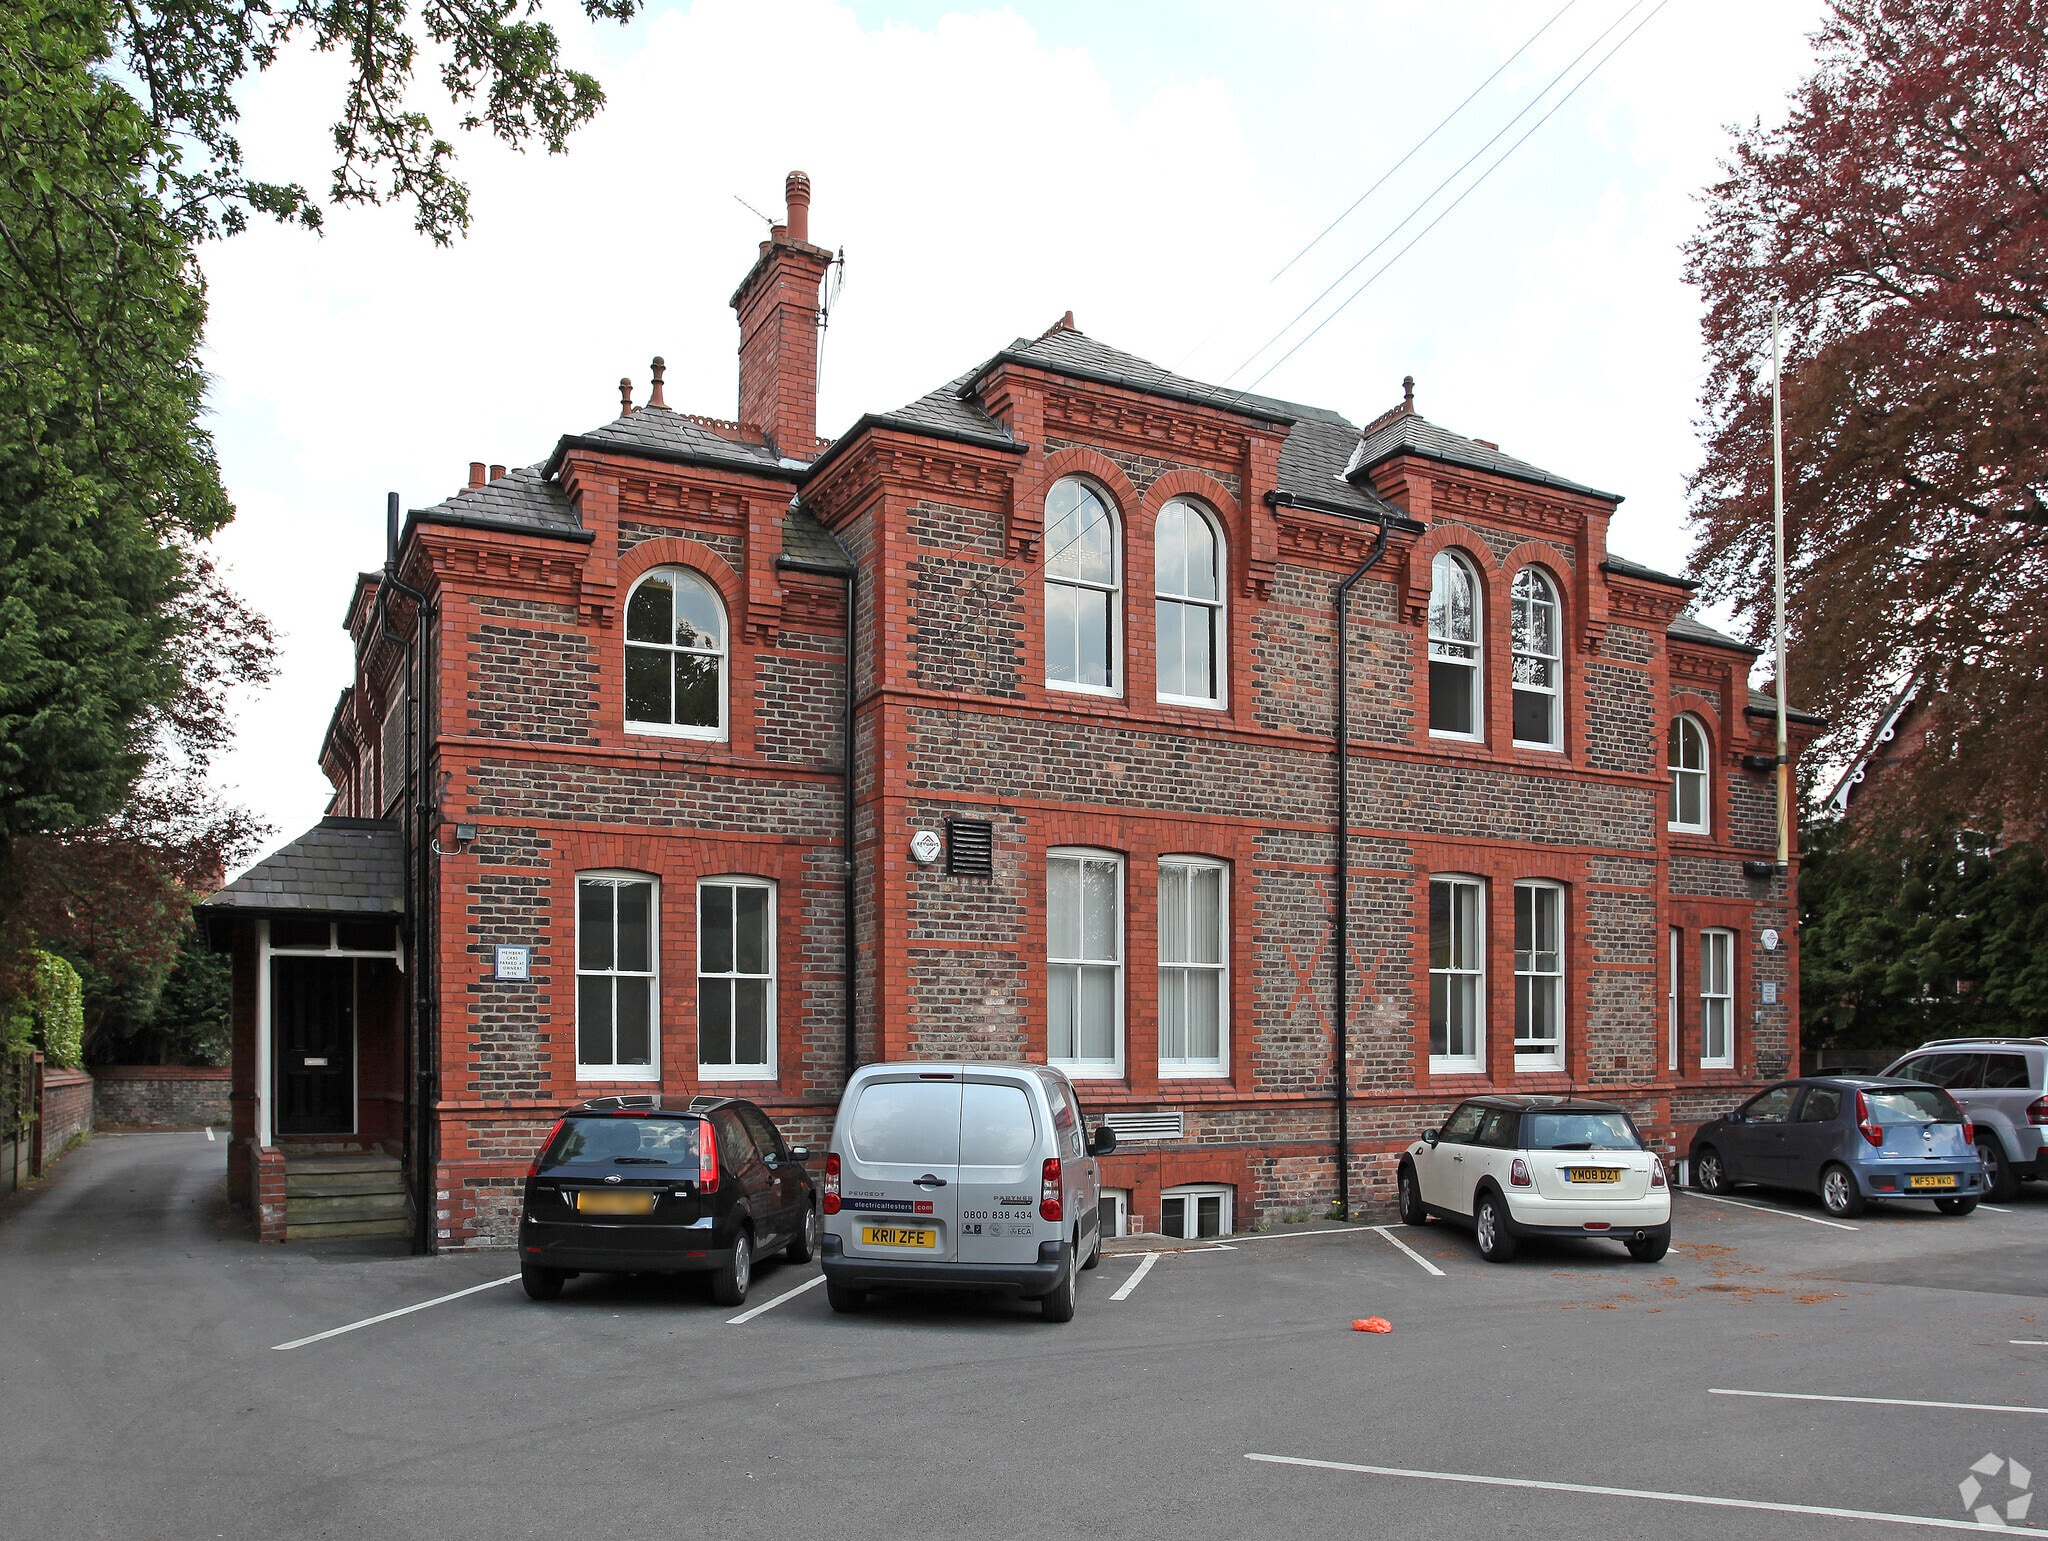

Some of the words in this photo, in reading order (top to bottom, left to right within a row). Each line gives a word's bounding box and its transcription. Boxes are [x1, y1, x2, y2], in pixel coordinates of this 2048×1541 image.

[1571, 1170, 1598, 1180] YM08
[1600, 1170, 1619, 1180] DZT
[854, 1202, 912, 1210] electricaltesters
[963, 1210, 989, 1219] 0800
[991, 1210, 1011, 1219] 838
[1013, 1211, 1033, 1219] 434
[871, 1229, 897, 1243] KR11
[898, 1230, 926, 1244] ZFE
